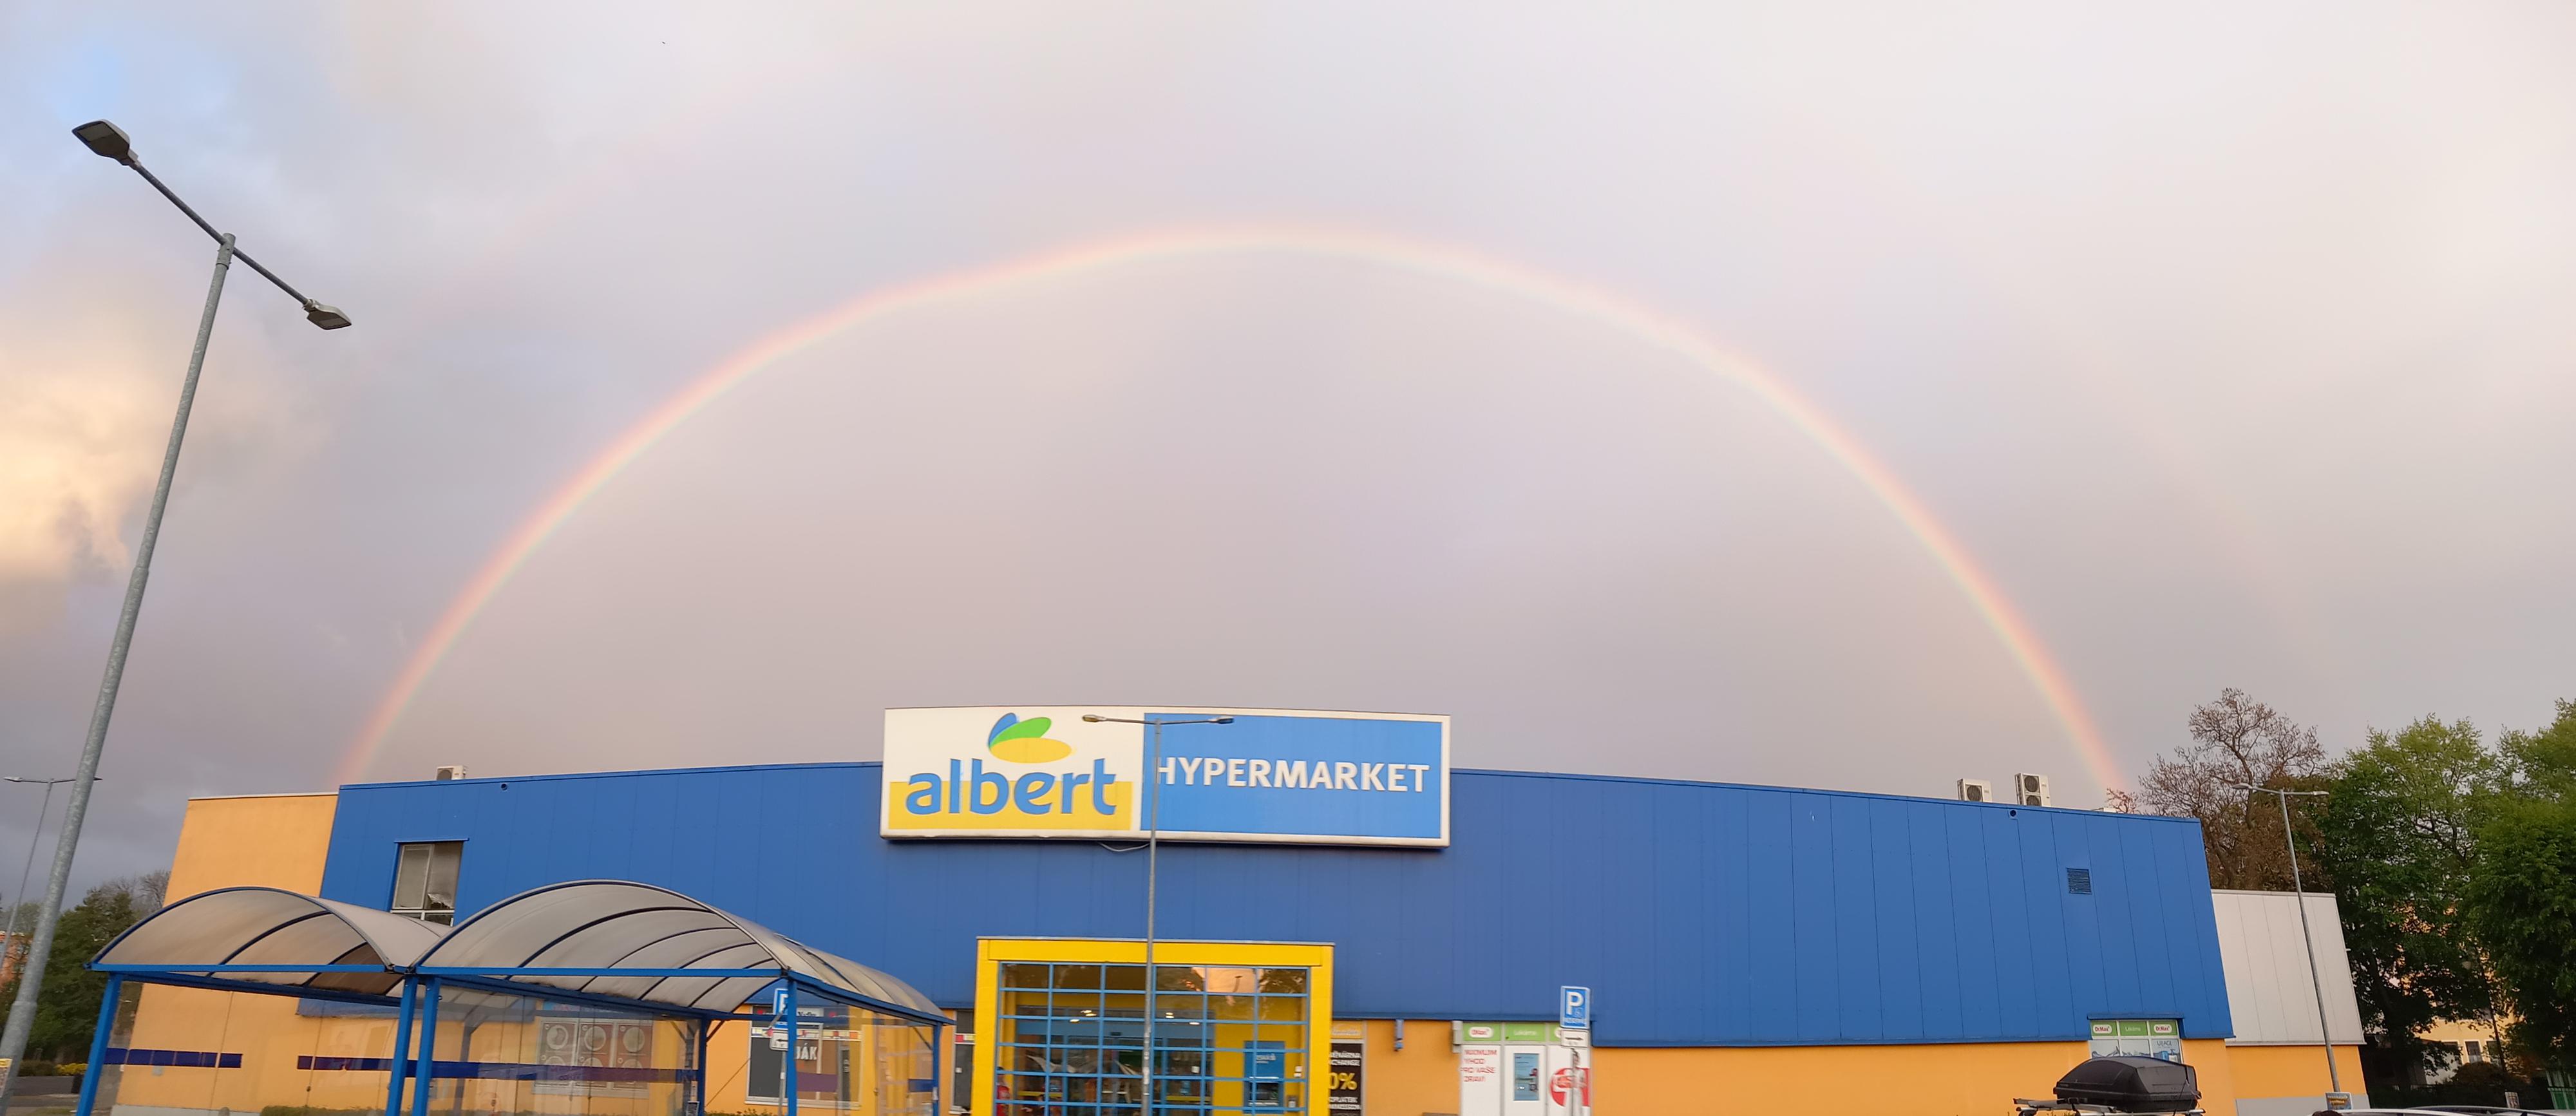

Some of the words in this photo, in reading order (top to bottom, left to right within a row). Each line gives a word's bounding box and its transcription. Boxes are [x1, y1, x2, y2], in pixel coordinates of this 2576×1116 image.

[905, 757, 1117, 815] albert
[1156, 756, 1430, 792] HYPERMARKET
[1566, 991, 1584, 1015] P
